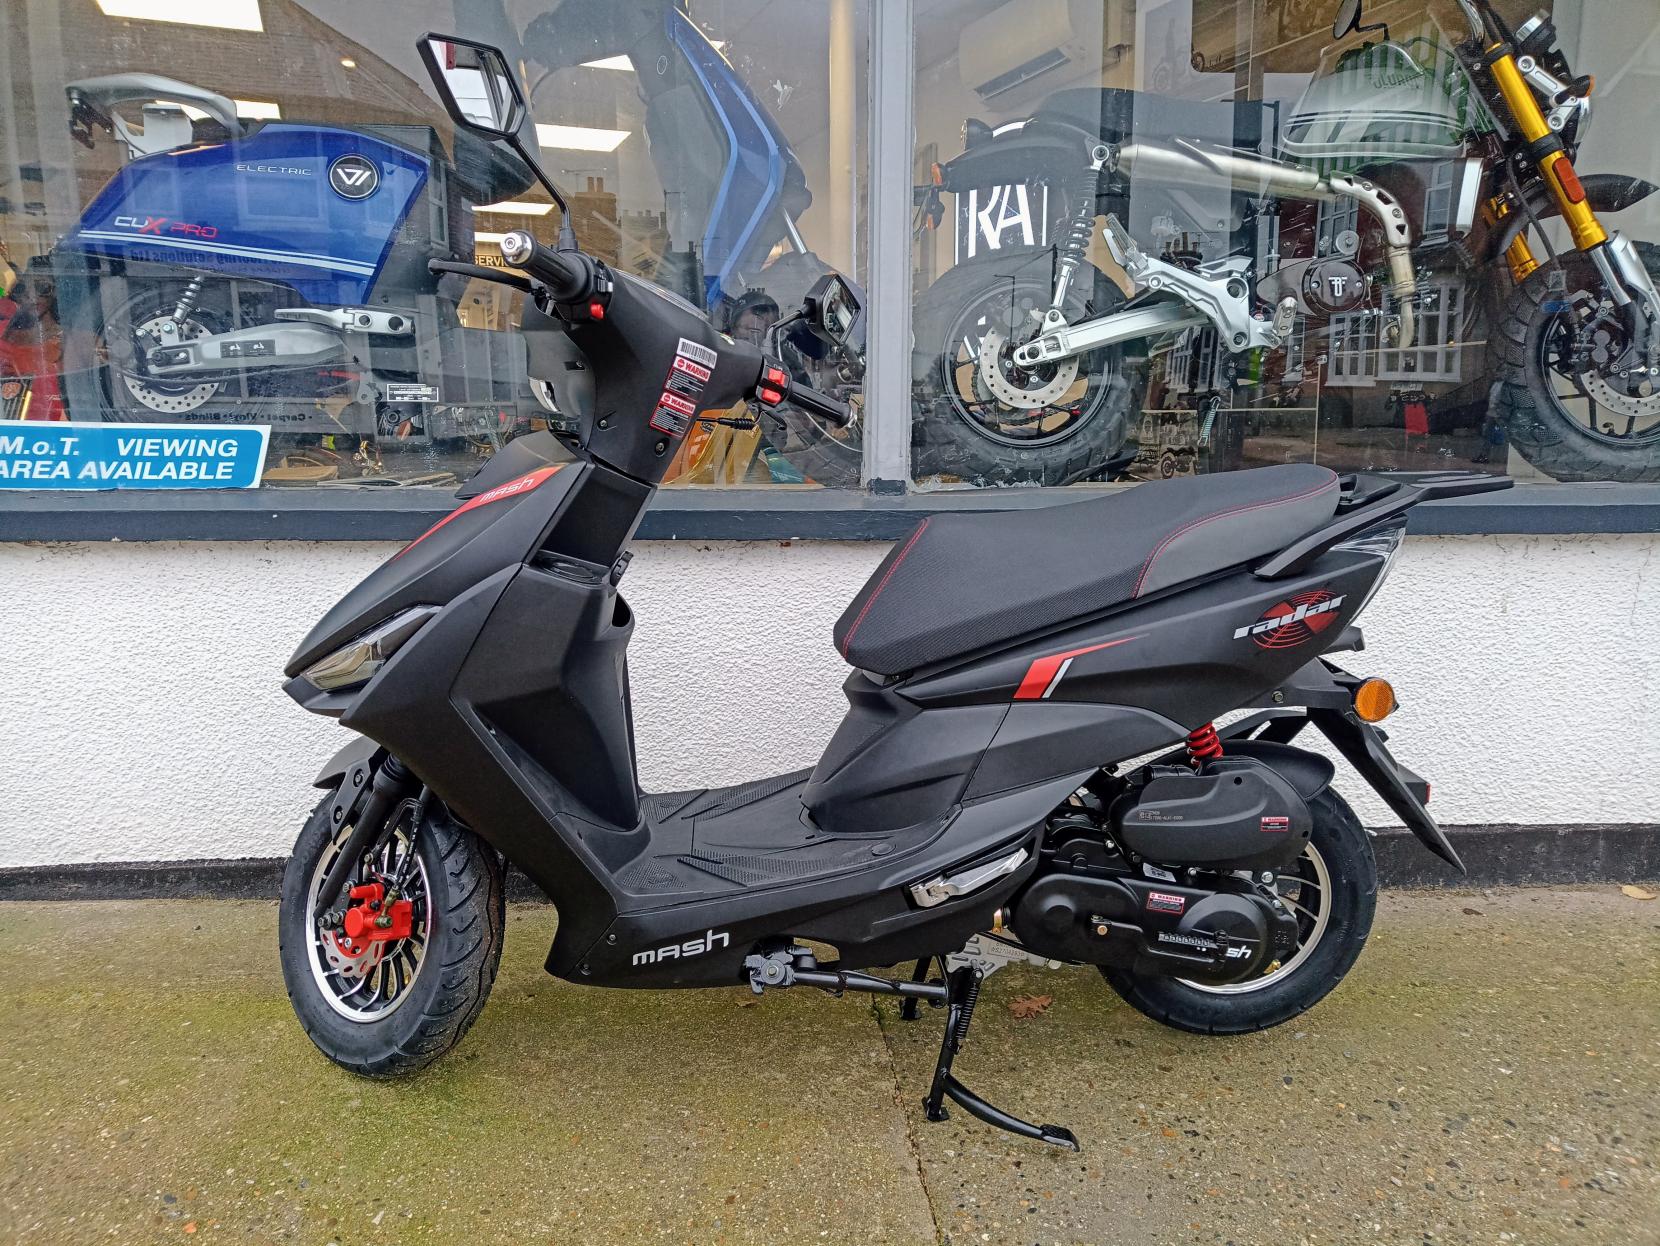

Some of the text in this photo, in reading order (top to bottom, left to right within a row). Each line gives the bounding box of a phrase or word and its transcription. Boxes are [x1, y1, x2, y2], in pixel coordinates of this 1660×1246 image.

[236, 164, 312, 176] ELECTRIC
[114, 216, 218, 239] CUX PRO
[0, 436, 239, 457] M.o.T. VIEWING
[0, 460, 235, 480] AREA AVAILABLE
[1233, 594, 1348, 640] radar
